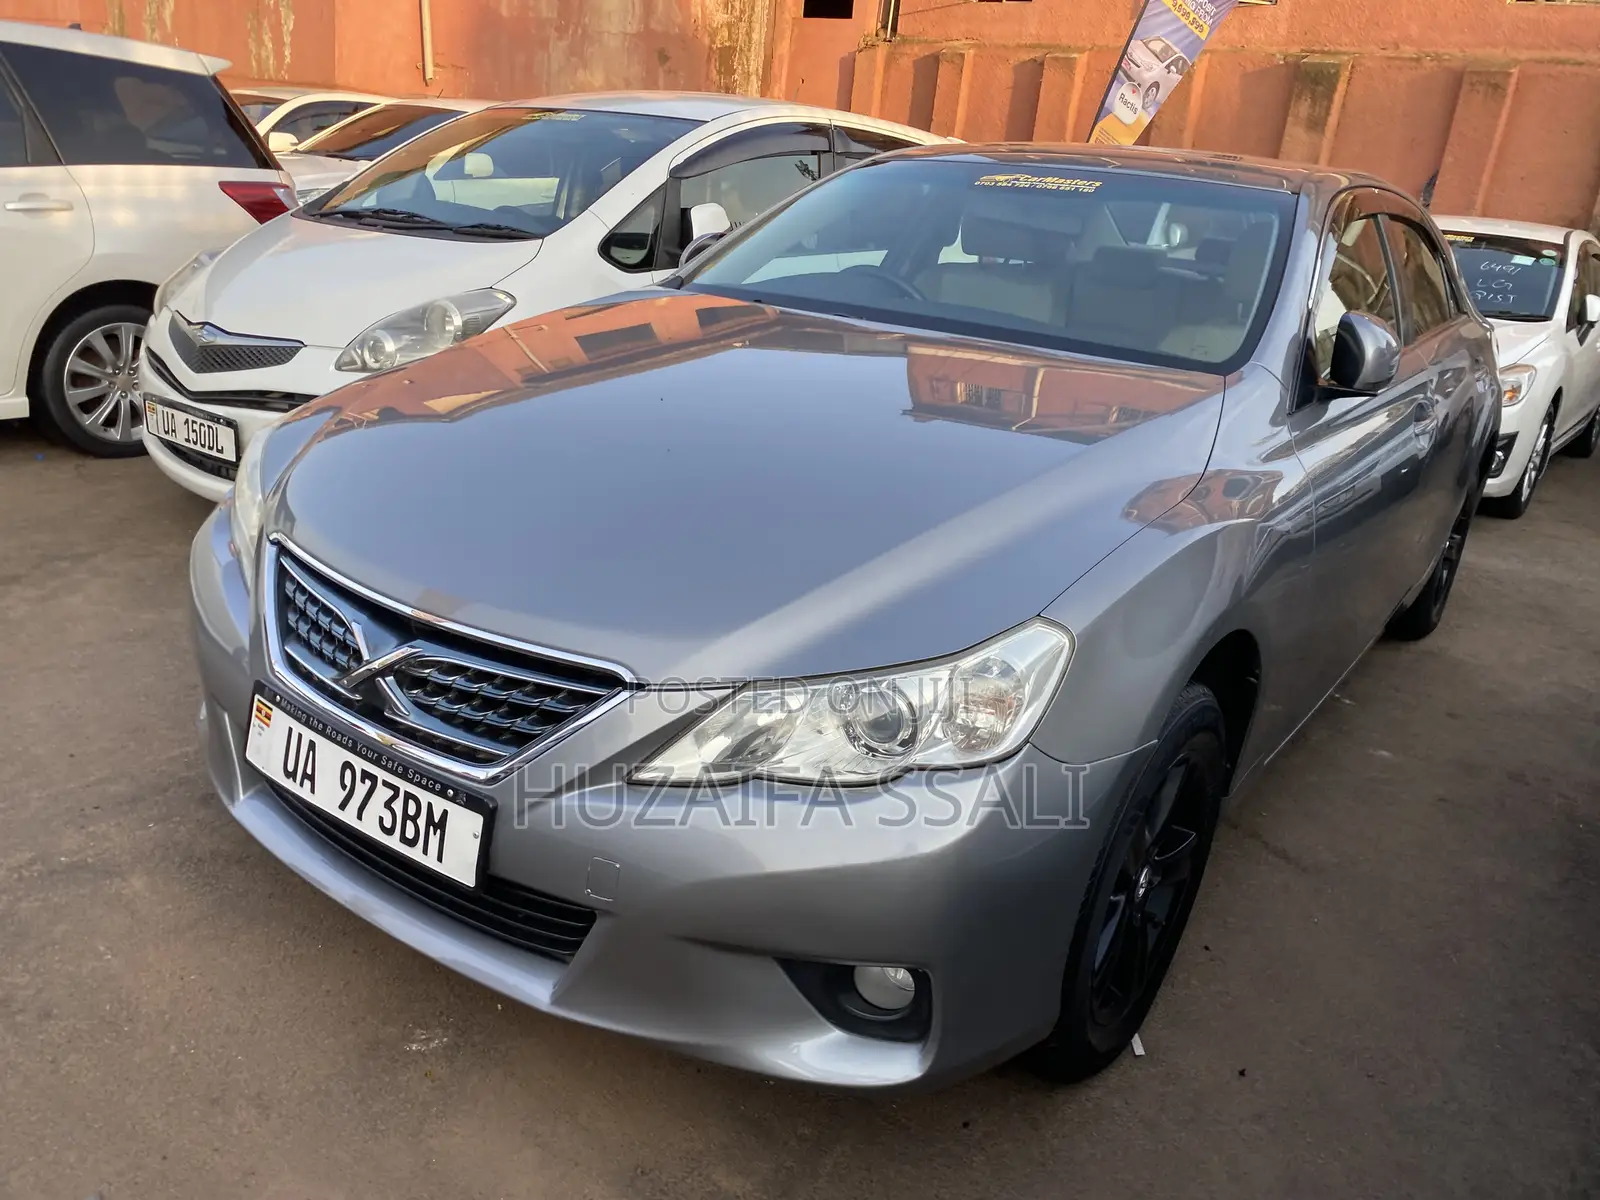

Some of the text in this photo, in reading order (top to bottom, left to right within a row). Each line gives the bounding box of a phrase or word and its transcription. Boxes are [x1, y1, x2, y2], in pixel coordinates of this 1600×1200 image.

[1119, 93, 1139, 115] Ractis
[1019, 174, 1103, 187] CarMasters
[161, 409, 178, 440] UA
[183, 417, 224, 455] 150DL
[280, 698, 442, 792] Making the Roads Your Safe Space
[282, 726, 450, 864] UA 973BM
